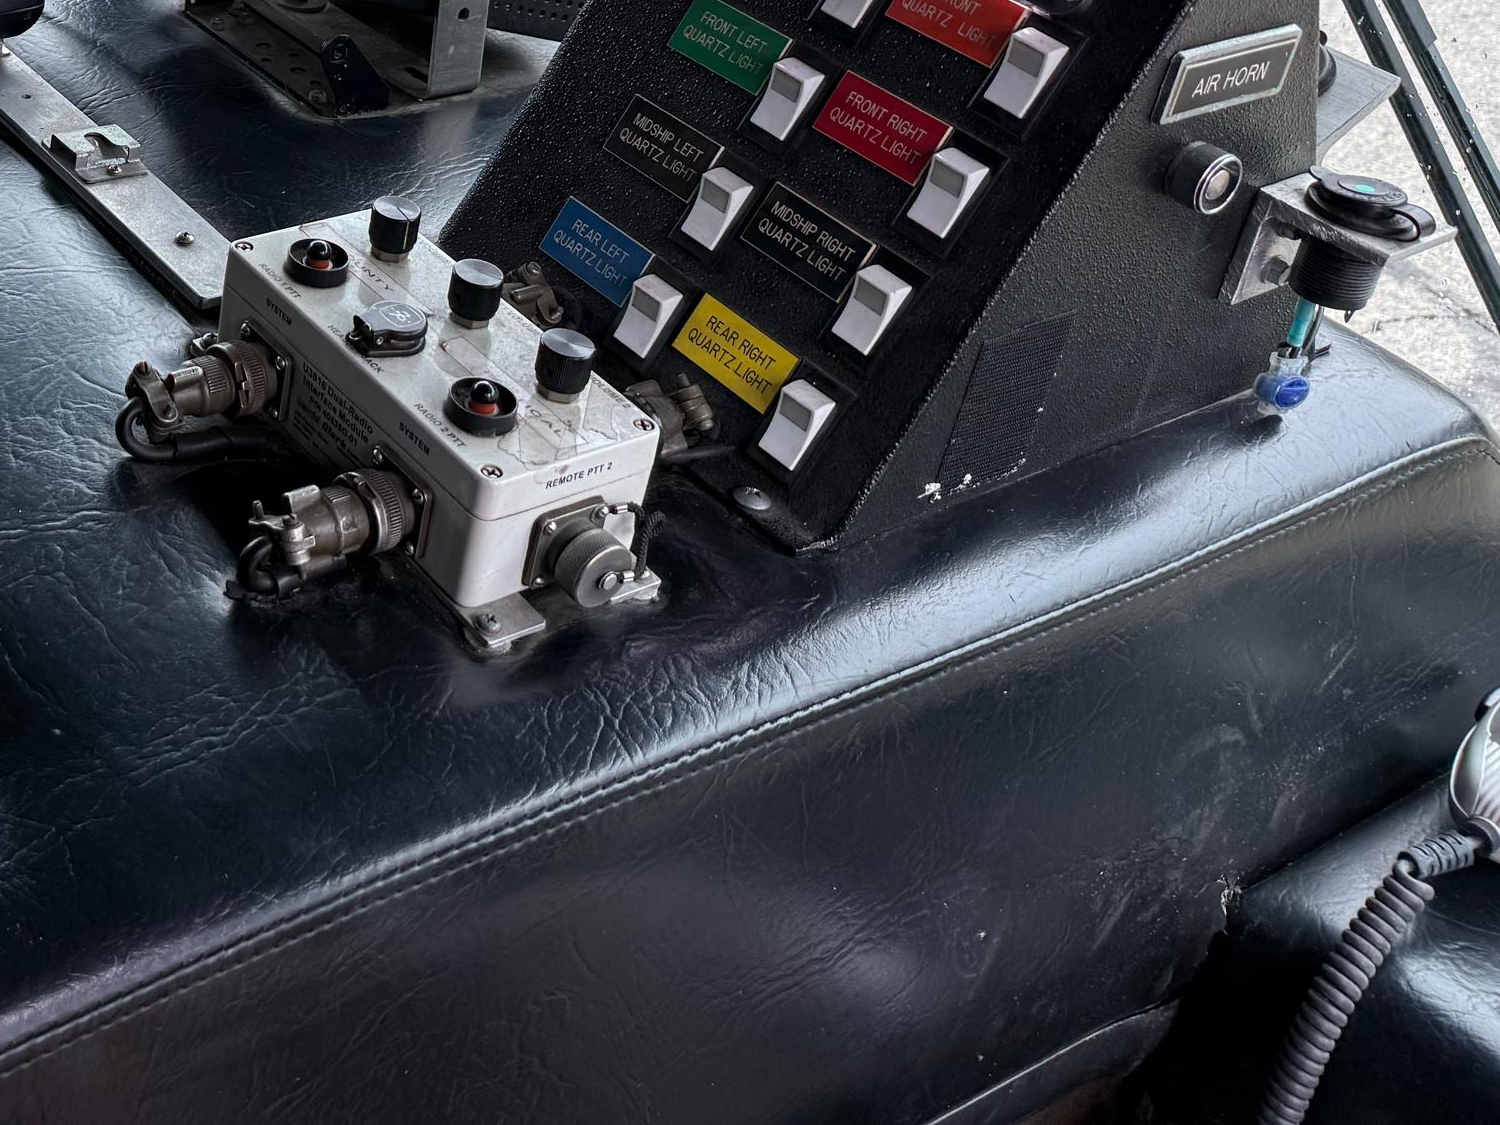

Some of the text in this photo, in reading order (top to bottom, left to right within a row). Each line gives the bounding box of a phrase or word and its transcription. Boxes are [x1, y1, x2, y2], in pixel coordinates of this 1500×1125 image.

[683, 24, 764, 74] QUARTZ LIGHT
[700, 11, 768, 53] FRONT LEFT
[957, 21, 997, 48] LIGHT
[1191, 60, 1270, 98] AIR HORN
[633, 113, 704, 162] MIDSHIP LEFT
[829, 107, 921, 164] QUARTZ LIGHT
[845, 91, 928, 143] FRONT RIGHT
[619, 127, 697, 182] QUARTZ LIGHT
[572, 219, 630, 263] REAR LEFT
[758, 218, 846, 281] QUARTZ LIGHT
[770, 201, 856, 262] MIDSHIP RIGHT
[258, 262, 282, 283] RADIO
[286, 285, 302, 300] PTT
[553, 229, 628, 285] QUARTZ LIGHT
[265, 298, 292, 325] SYSTEM
[688, 328, 773, 394] QUARTZ LIGHT
[705, 315, 777, 370] REAR RIGHT
[303, 375, 337, 413] Interface
[339, 410, 368, 443] Module
[328, 386, 373, 435] Dual-Radio
[413, 403, 443, 428] RADIO
[447, 431, 468, 448] PTT
[399, 422, 431, 455] SYSTEM
[545, 461, 613, 490] REMOTE PTT 2
